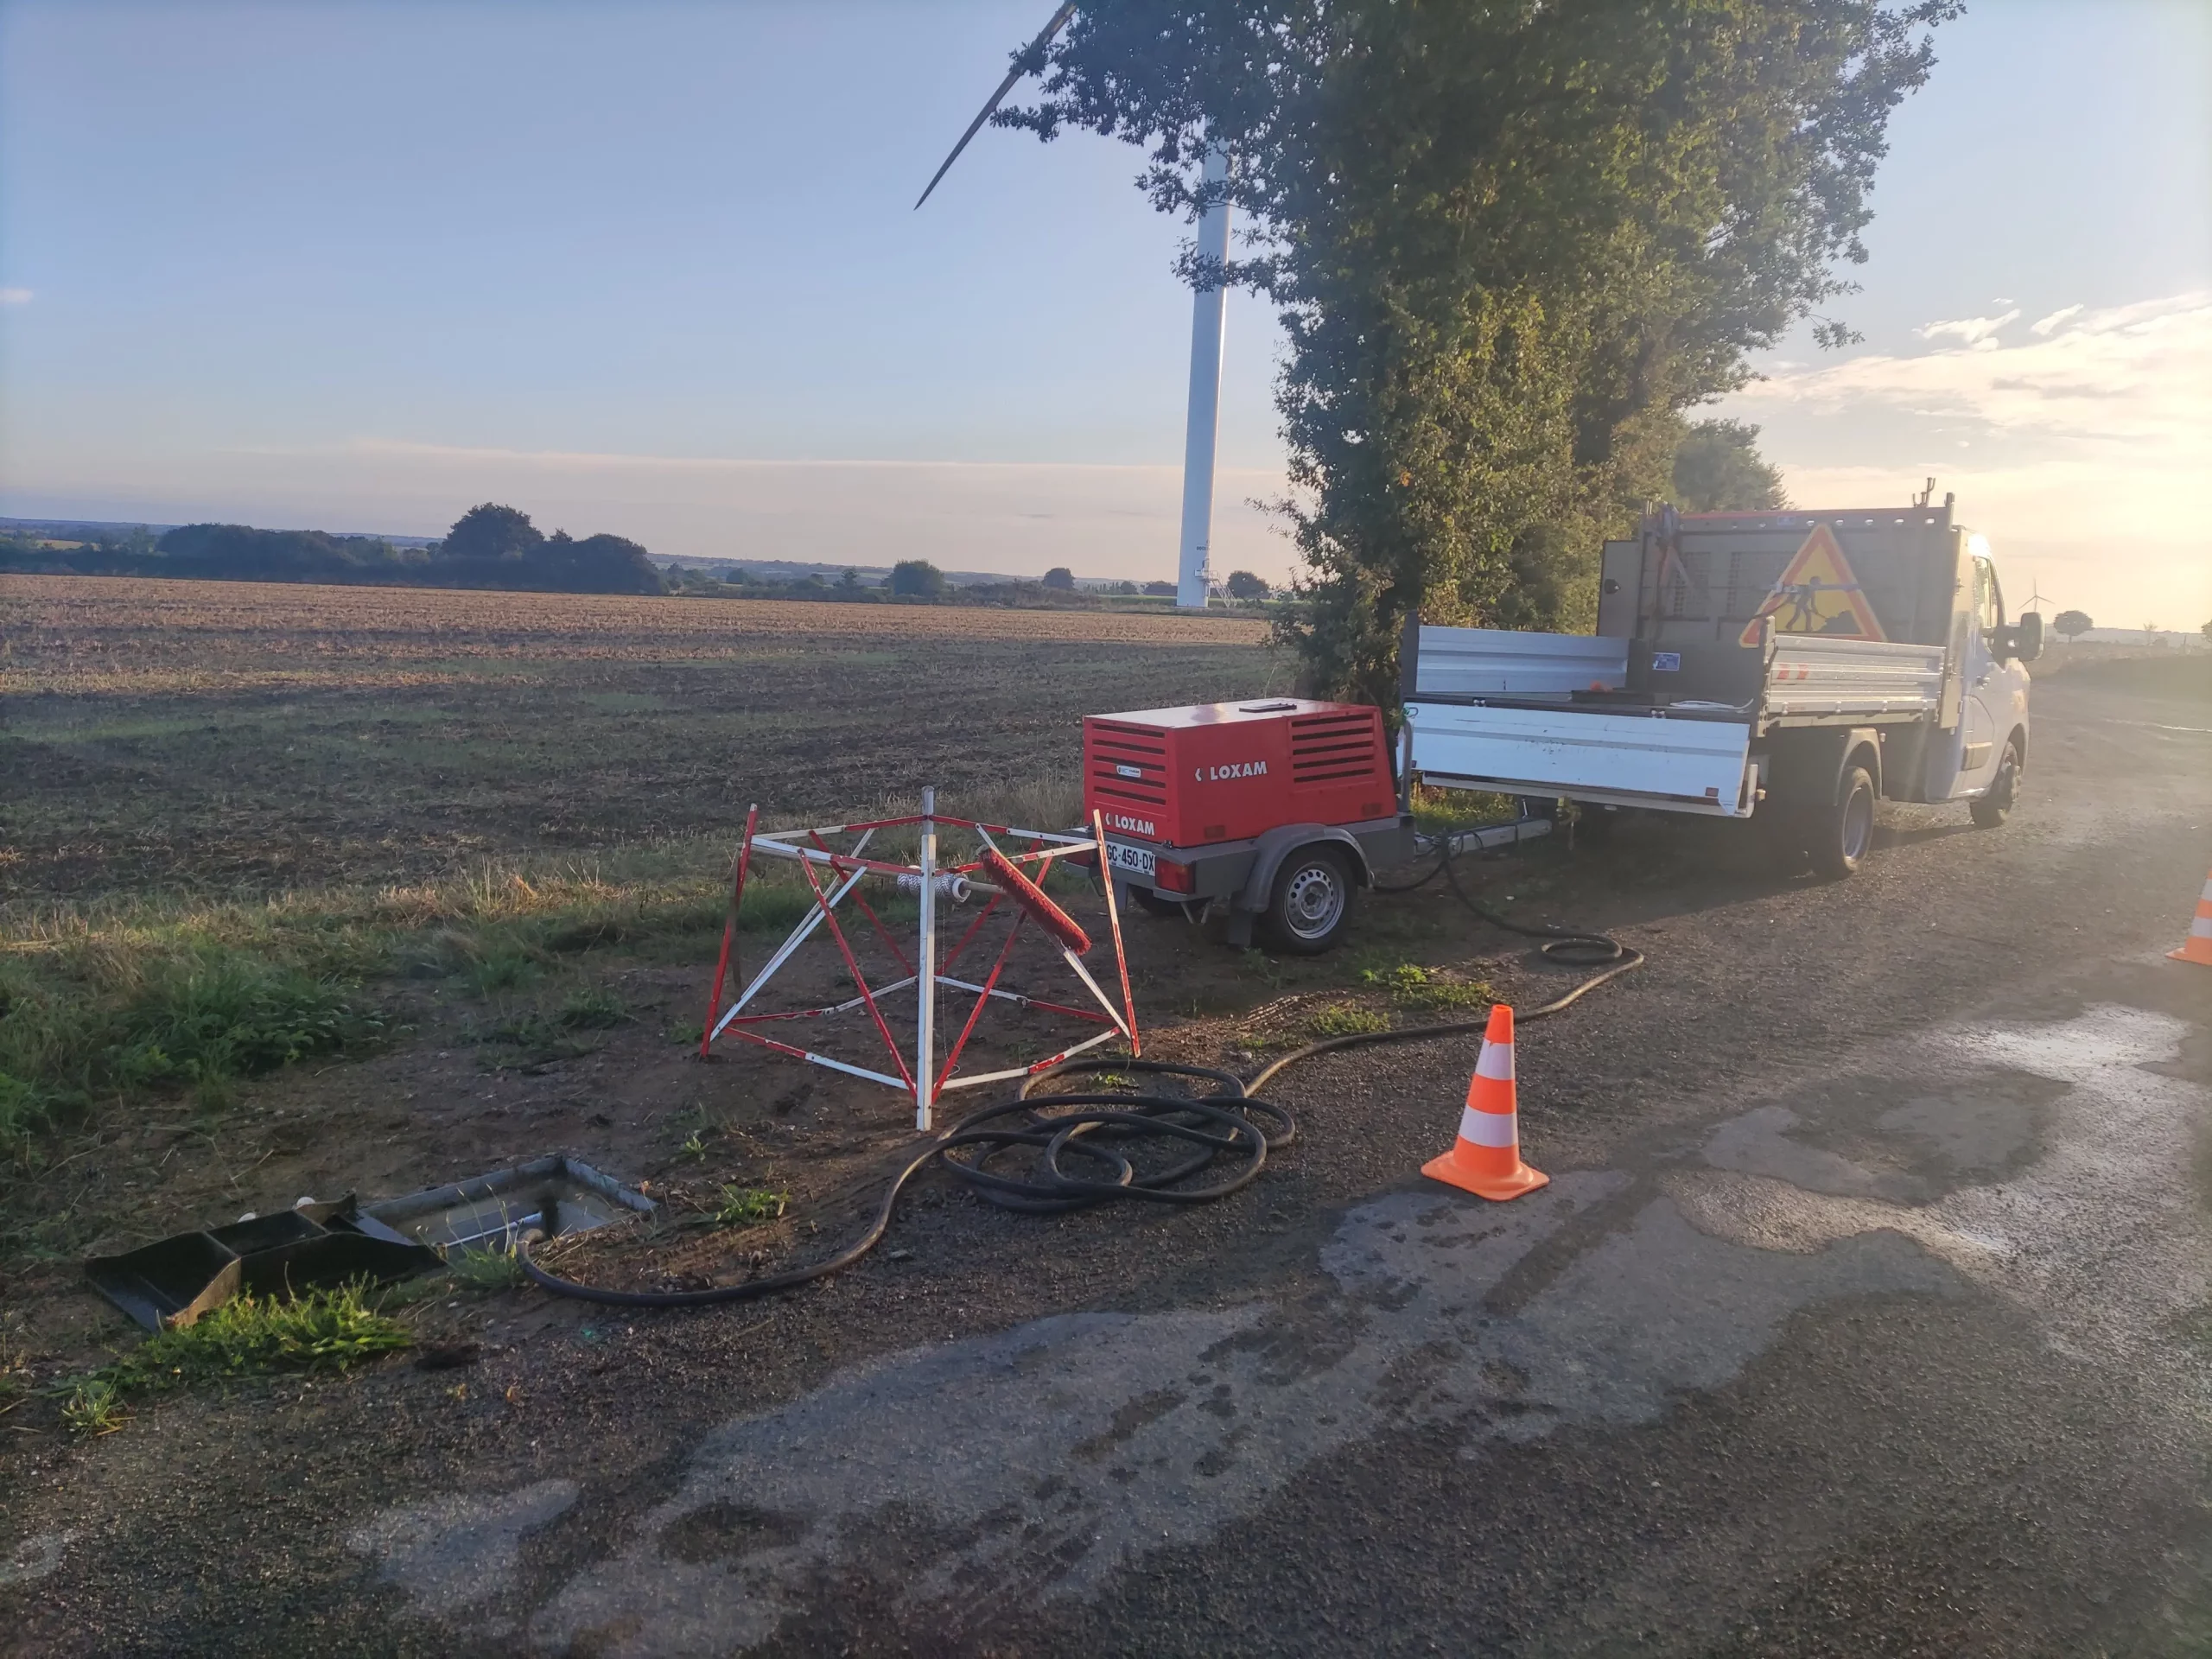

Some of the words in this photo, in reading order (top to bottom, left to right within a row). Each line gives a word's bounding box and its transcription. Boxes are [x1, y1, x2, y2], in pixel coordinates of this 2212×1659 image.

[1210, 760, 1268, 780] LOXAM
[1115, 814, 1155, 836] LOXAM
[1106, 844, 1154, 872] GC-450-DX
